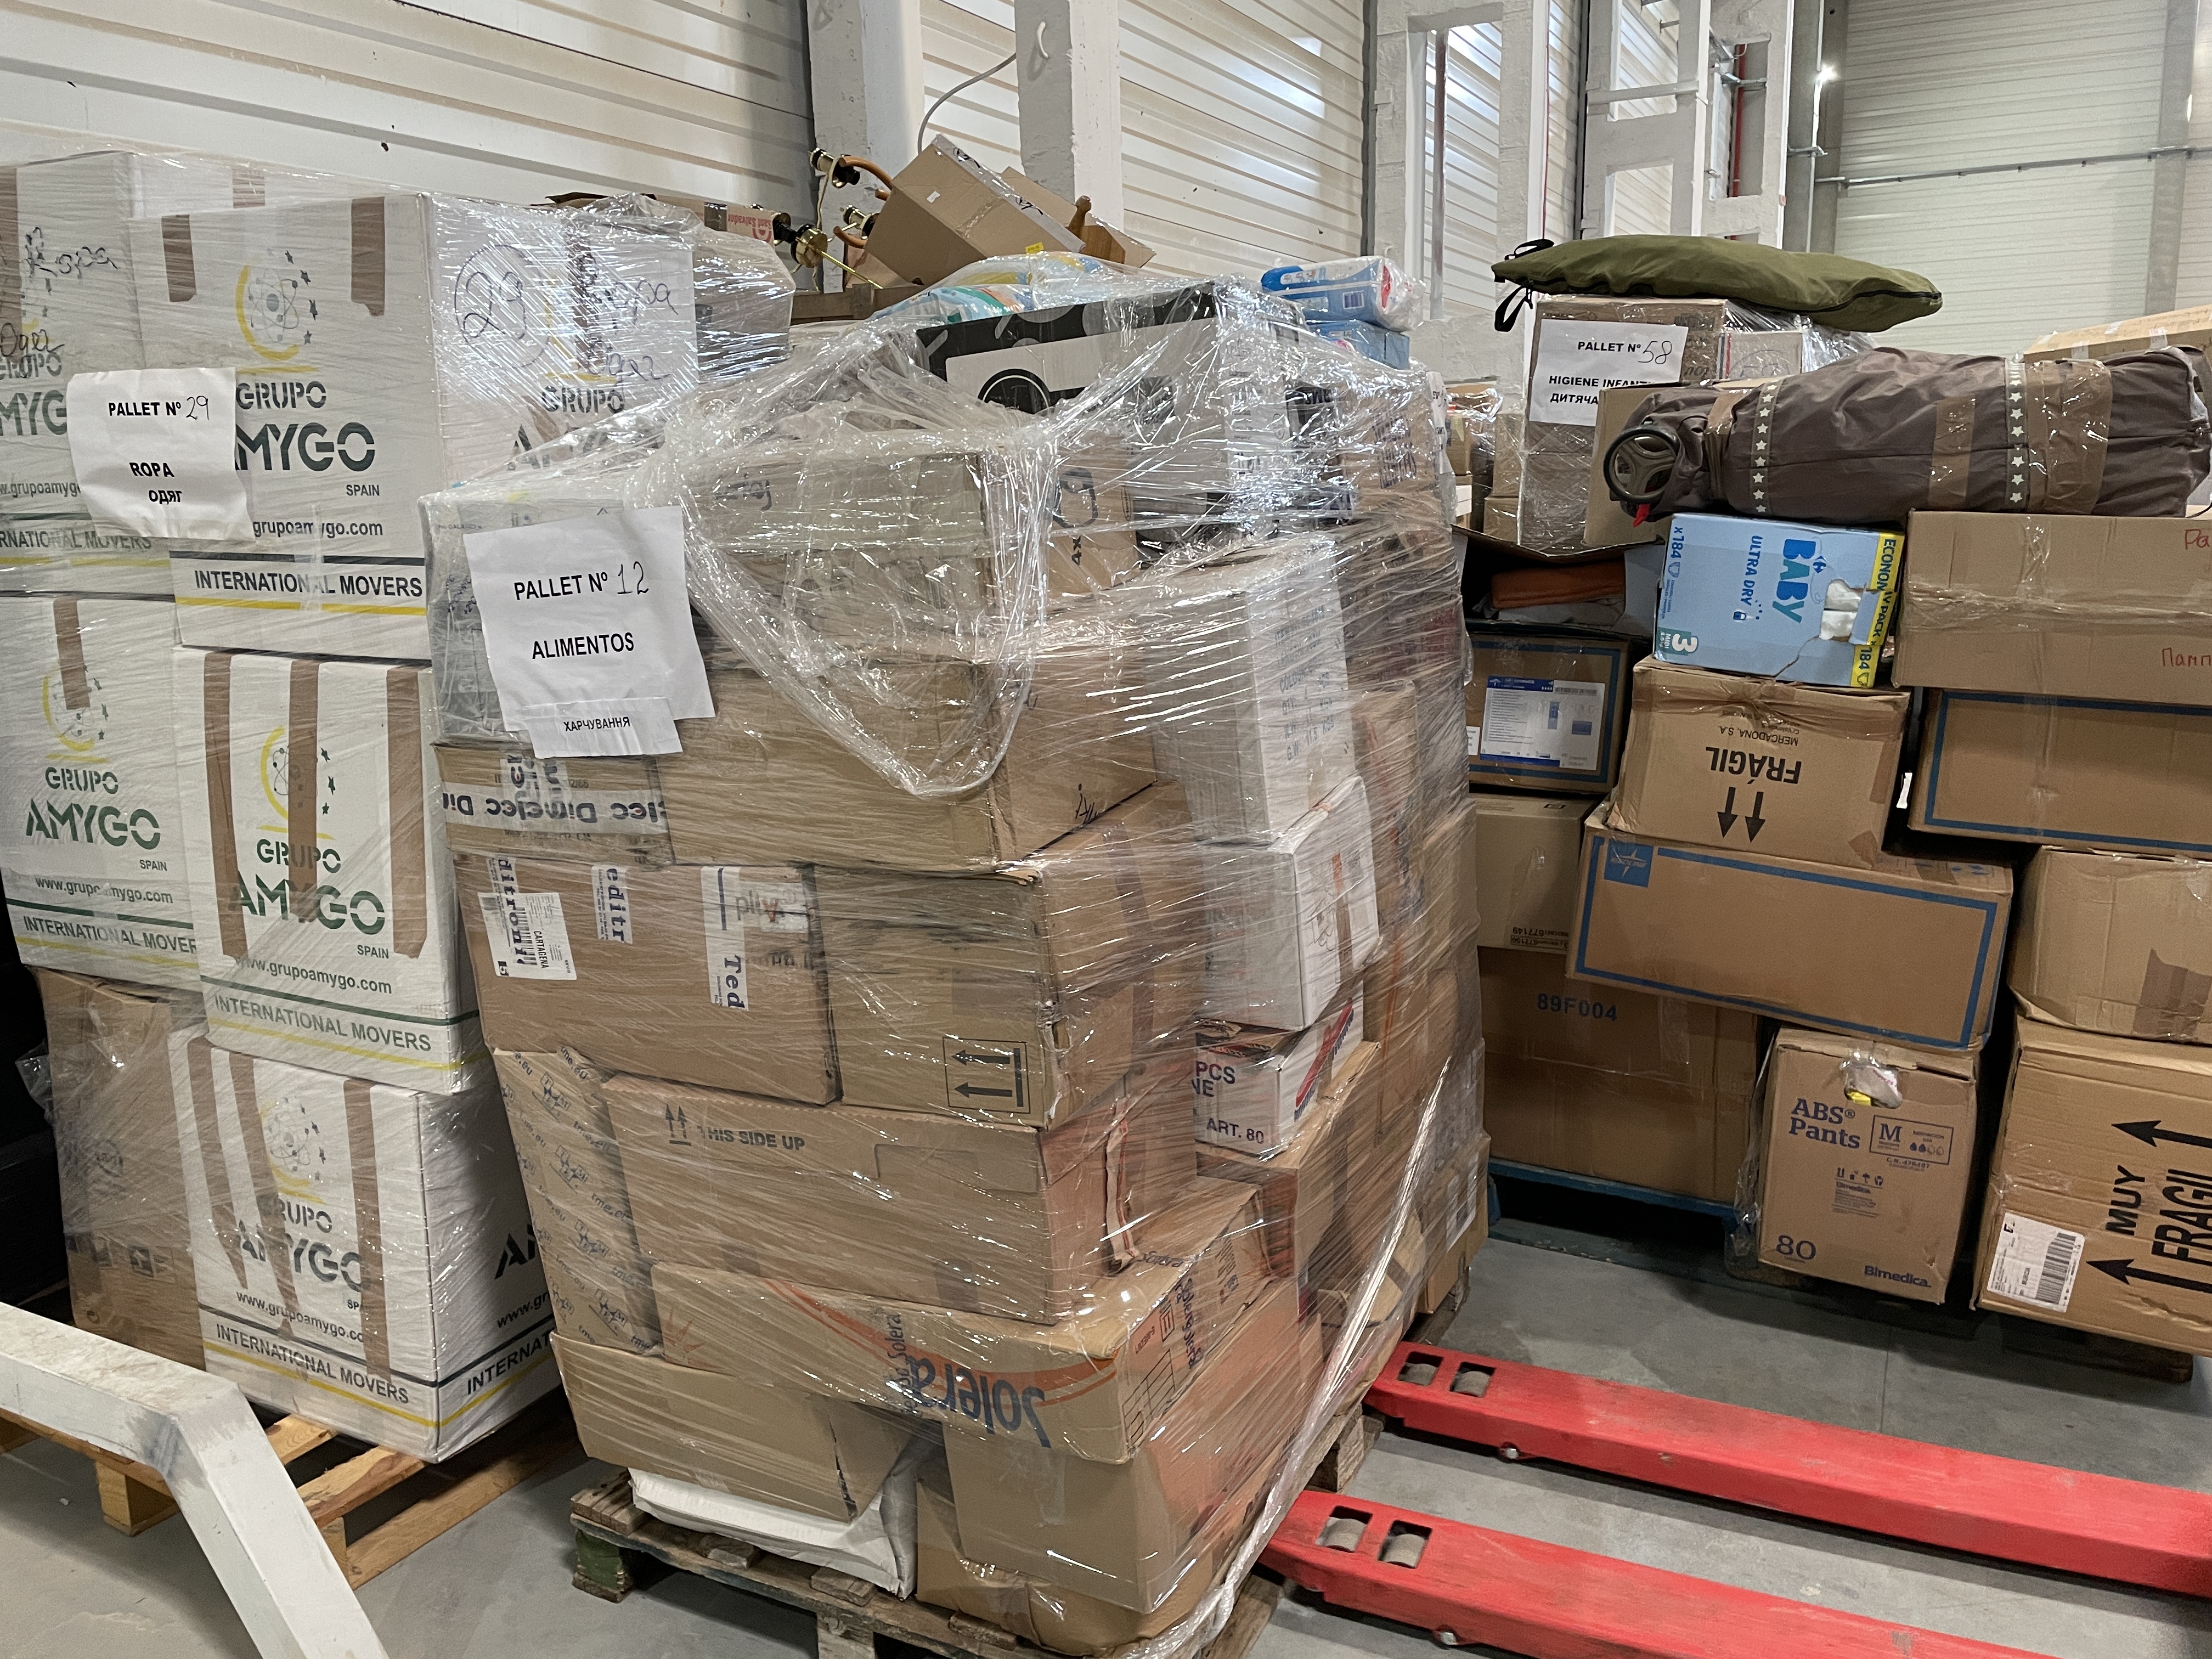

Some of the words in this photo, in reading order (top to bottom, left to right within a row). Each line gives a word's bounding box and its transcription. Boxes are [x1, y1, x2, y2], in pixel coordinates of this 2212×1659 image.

[1577, 341, 1624, 352] PALLET
[1637, 340, 1673, 365] 58
[1549, 375, 1599, 387] HIGIENE
[109, 402, 160, 416] PALLET
[185, 395, 210, 421] 29
[236, 381, 326, 409] GRUPO
[541, 386, 625, 414] GRUPO
[1550, 393, 1599, 405] ДИТЯЧА
[235, 422, 375, 472] MYGO
[129, 462, 174, 478] ROPA
[149, 490, 182, 505] ОДЯГ
[346, 484, 380, 497] SPAIN
[1745, 535, 1763, 576] ULTRA
[340, 575, 423, 597] MOVERS
[514, 575, 582, 601] PALLET
[617, 561, 650, 595] 12
[1740, 580, 1755, 606] DRY
[1772, 539, 1816, 623] BABY
[1872, 605, 1888, 638] PACK
[532, 632, 635, 659] ALIMENTOS
[1672, 634, 1698, 653] 3
[1858, 647, 1872, 670] 184
[563, 716, 631, 732] ХАРЧУВАННЯ
[1737, 729, 1799, 746] MERCADONA,
[1706, 746, 1803, 785] FRÁGIL
[45, 767, 119, 795] GRUPO
[26, 798, 161, 850] AMYGO
[139, 859, 167, 871] SPAIN
[257, 839, 341, 874] GRUPO
[228, 871, 386, 935] AMYGO
[357, 945, 390, 960] SPAIN
[533, 930, 549, 969] CARTAGENA
[724, 955, 745, 1008] Ted
[1537, 993, 1618, 1022] 89F004
[214, 995, 348, 1039] INTERNATIONAL
[352, 1023, 432, 1052] MOVERS
[560, 1046, 588, 1080] tme.eu
[1195, 1061, 1235, 1084] PCS
[697, 1125, 734, 1143] THIS
[738, 1131, 778, 1147] SIDE
[781, 1135, 805, 1152] UP
[1206, 1118, 1242, 1138] ART.
[1246, 1128, 1265, 1144] 80
[1789, 1117, 1860, 1149] Pants
[1879, 1123, 1902, 1142] M
[2106, 1165, 2146, 1237] MUY
[1776, 1235, 1816, 1261] 80
[884, 1314, 908, 1360] Solera
[216, 1324, 336, 1379] INTERNATIONAL
[340, 1365, 409, 1404] MOVERS
